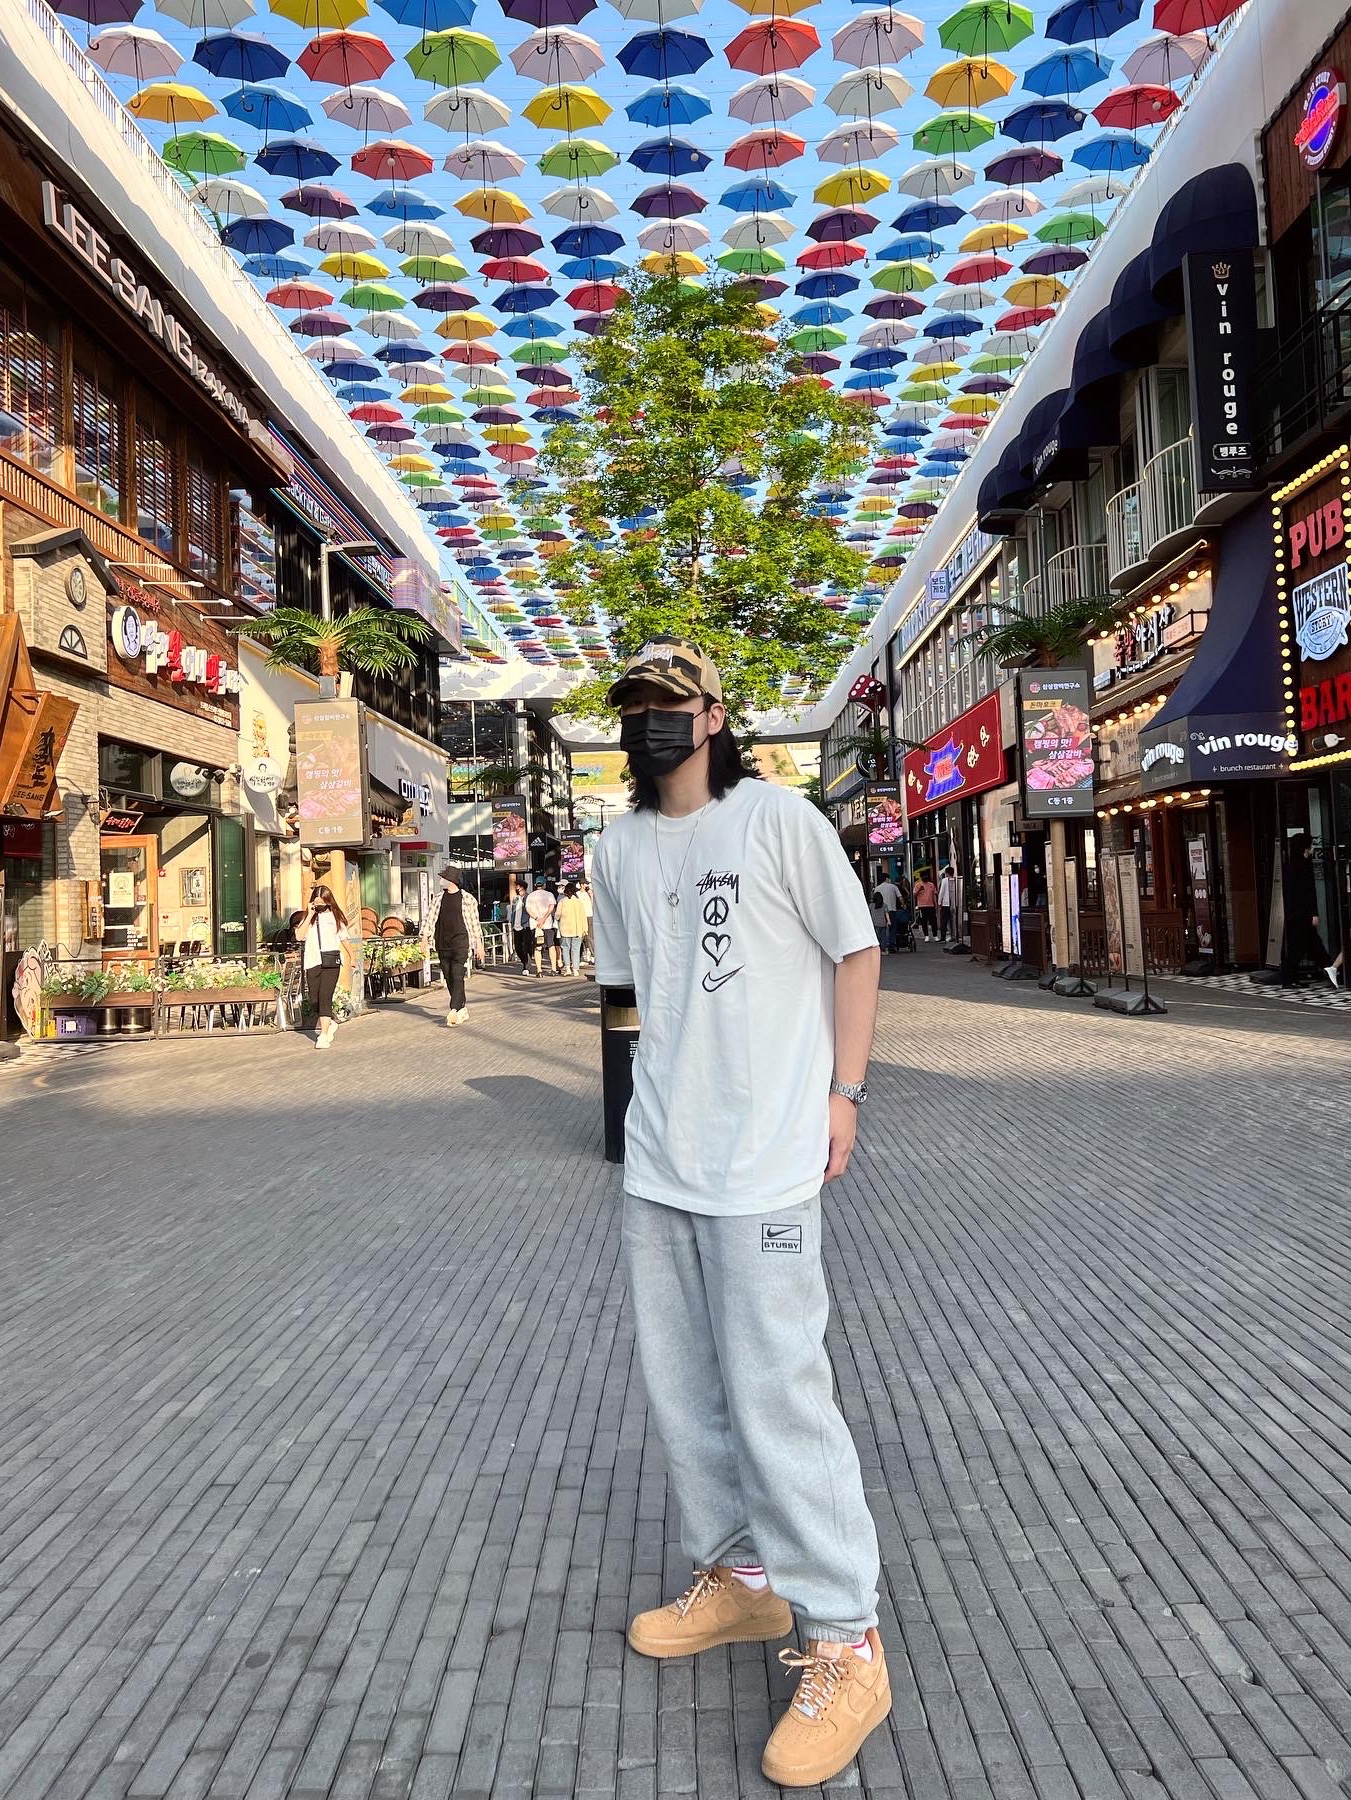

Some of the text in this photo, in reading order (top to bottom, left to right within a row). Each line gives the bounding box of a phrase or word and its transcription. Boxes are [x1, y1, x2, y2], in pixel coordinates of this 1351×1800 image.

[42, 181, 112, 285] LEE
[111, 258, 194, 371] SANG
[1216, 283, 1239, 436] vin rouge
[1289, 498, 1344, 570] PUB
[1294, 566, 1348, 632] WESTERN
[1311, 614, 1331, 633] STORY
[1300, 671, 1351, 732] BAR
[1155, 743, 1185, 765] rouge
[1197, 731, 1299, 756] vin rouge
[1219, 763, 1277, 773] brunch restaurant
[764, 1241, 799, 1250] STUSSY
